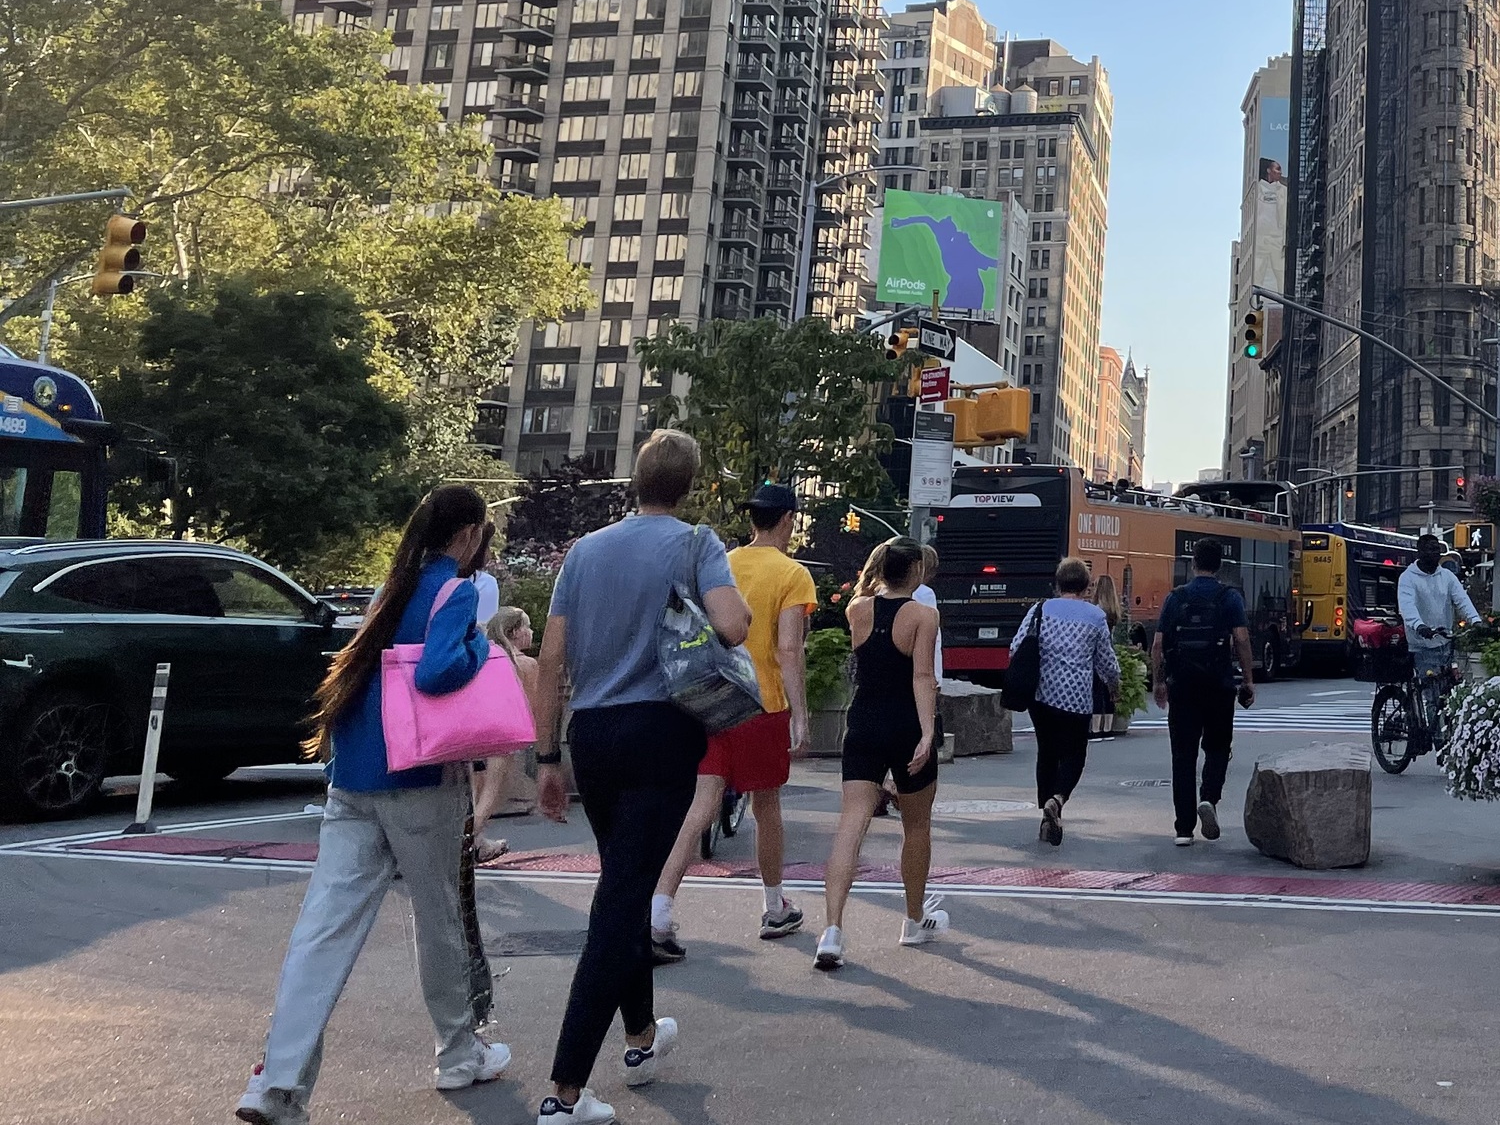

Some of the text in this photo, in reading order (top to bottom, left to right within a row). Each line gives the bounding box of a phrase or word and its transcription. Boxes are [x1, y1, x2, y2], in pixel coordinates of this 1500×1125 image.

[885, 277, 926, 290] AirPods
[924, 331, 951, 348] ONE WAY
[974, 495, 1015, 504] TOPVIEW
[1077, 512, 1120, 536] ONE WORLD
[1077, 538, 1120, 549] OBSERVATORY
